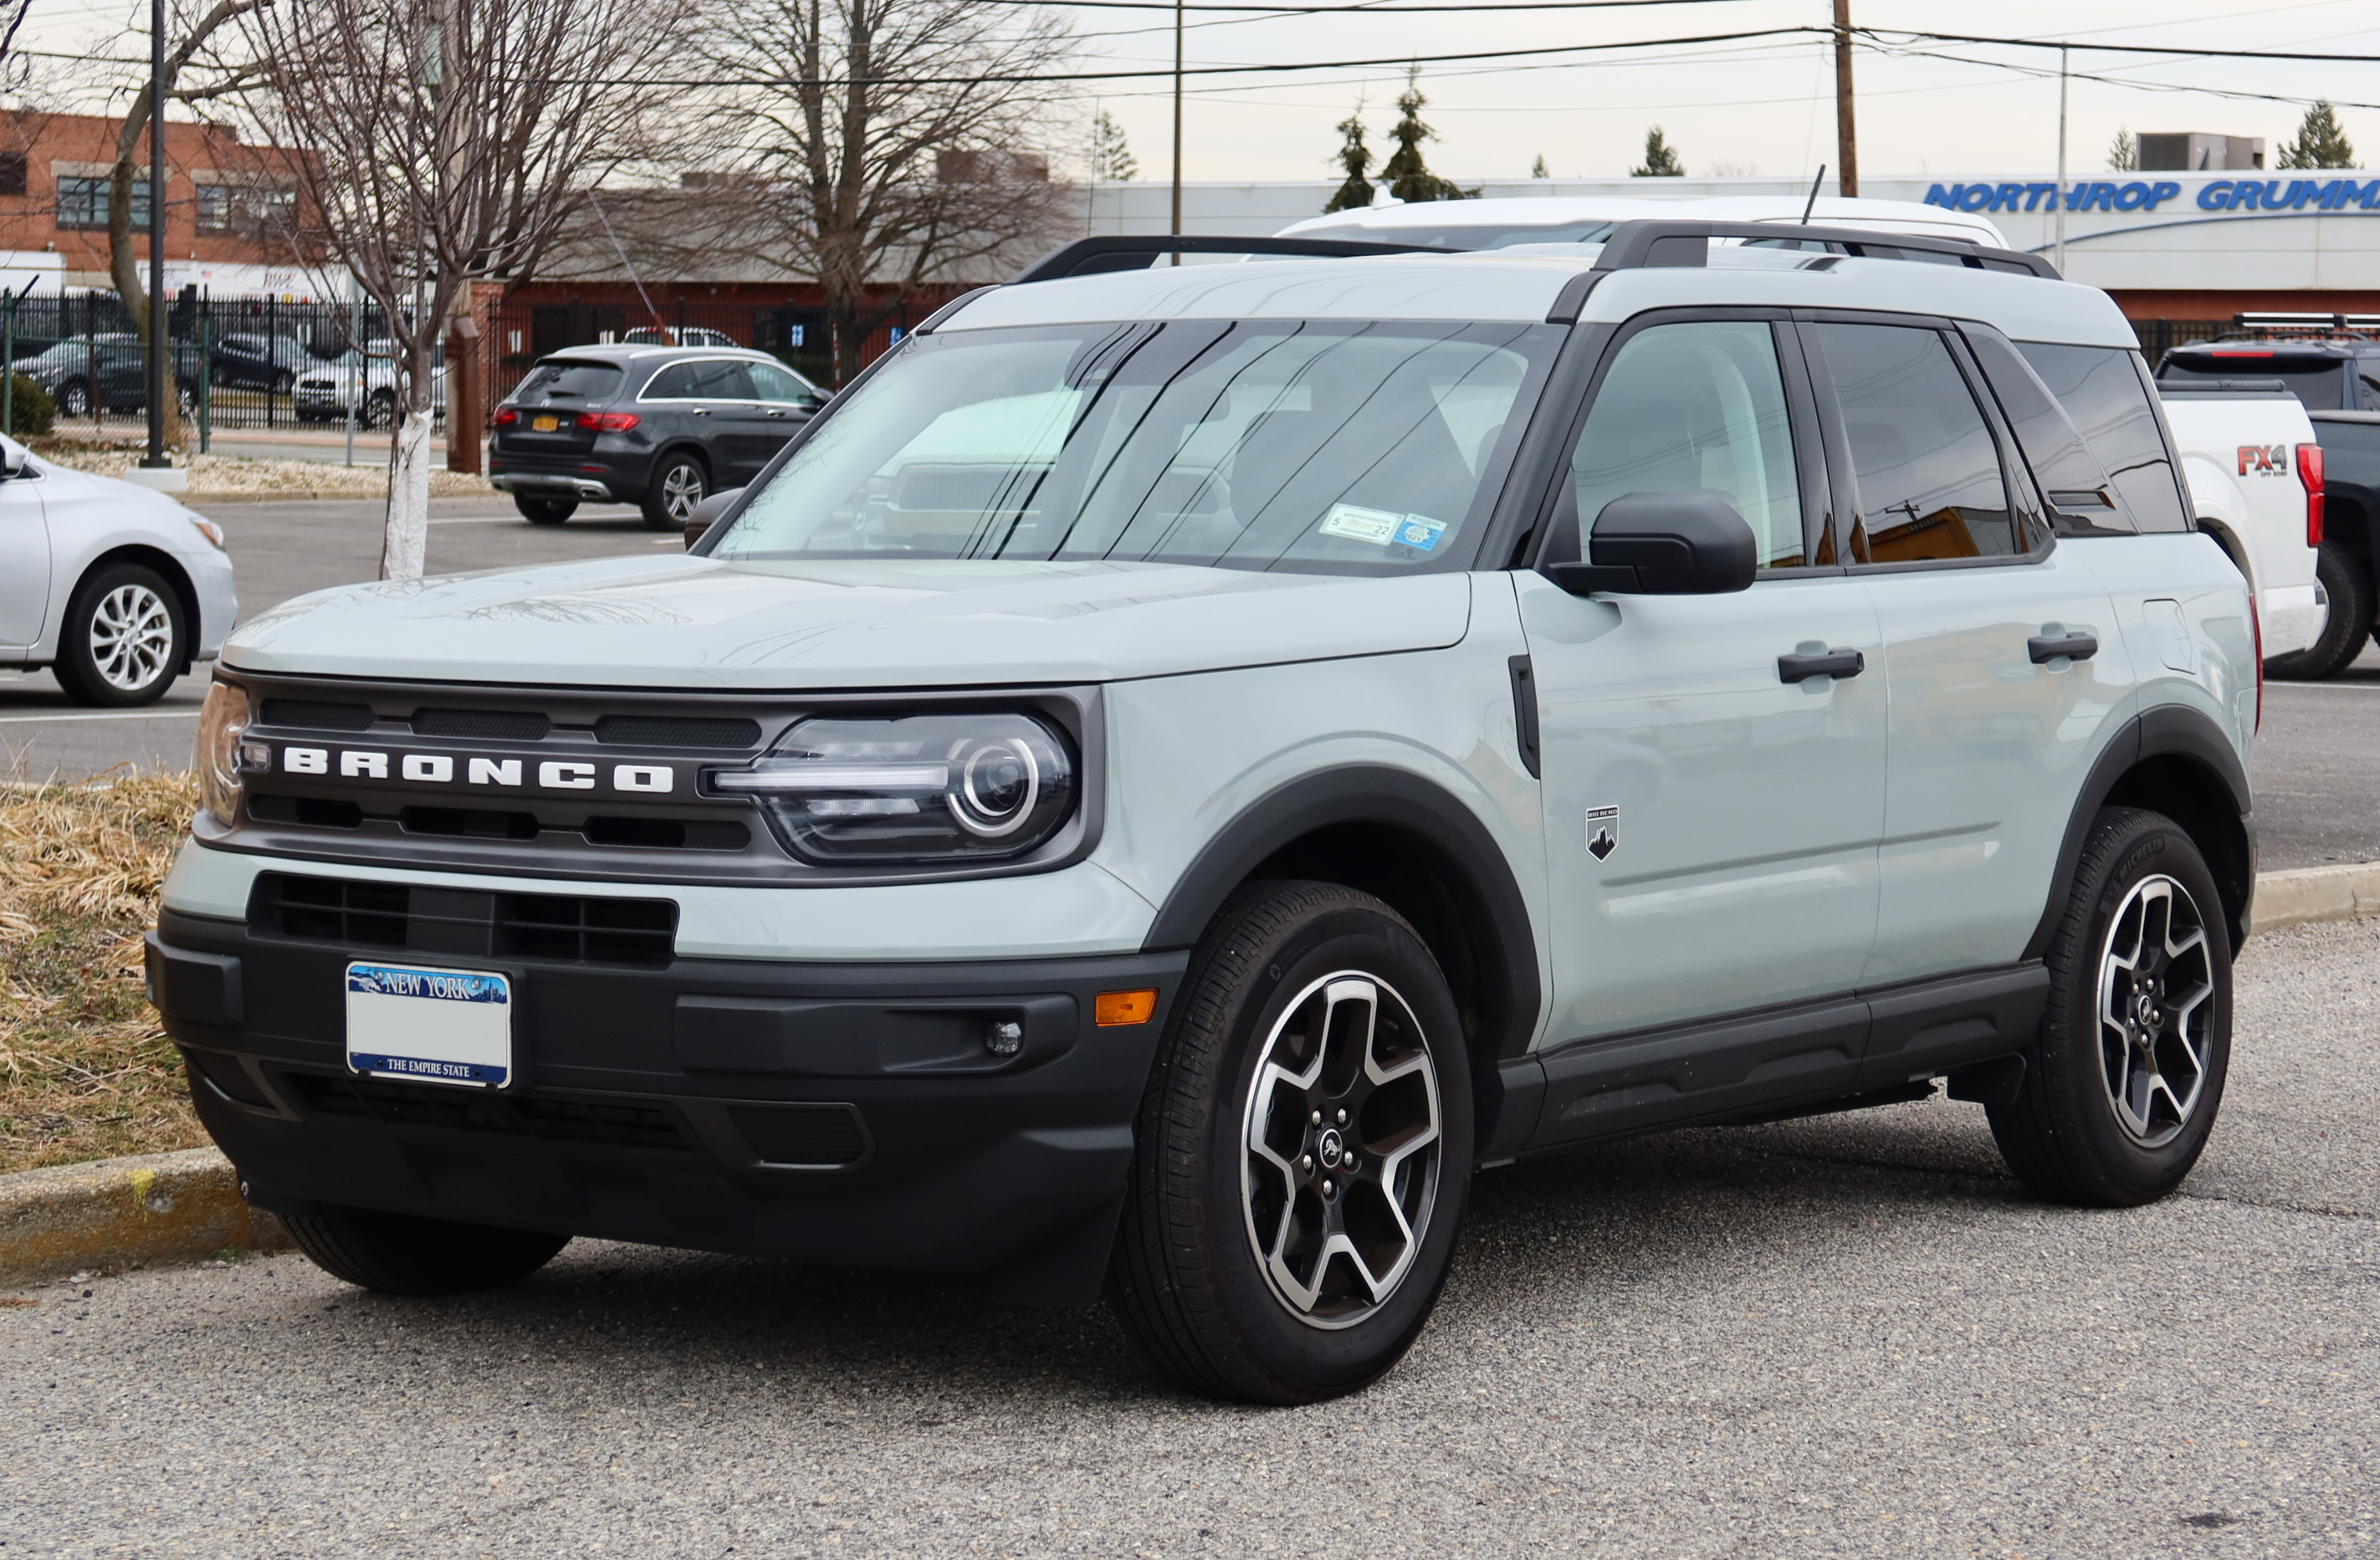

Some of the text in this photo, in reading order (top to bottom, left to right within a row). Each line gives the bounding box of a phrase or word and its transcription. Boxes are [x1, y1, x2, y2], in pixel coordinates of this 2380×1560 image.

[1924, 180, 2380, 212] NORTHROP GRUMM
[2237, 444, 2288, 476] FX4
[1332, 517, 1341, 526] 5
[1374, 524, 1390, 535] 22
[284, 746, 673, 794] BRONCO
[1599, 808, 1618, 816] BEND
[386, 971, 470, 1000] NEW YORK
[387, 1058, 470, 1077] THE EMPIRE STATE
